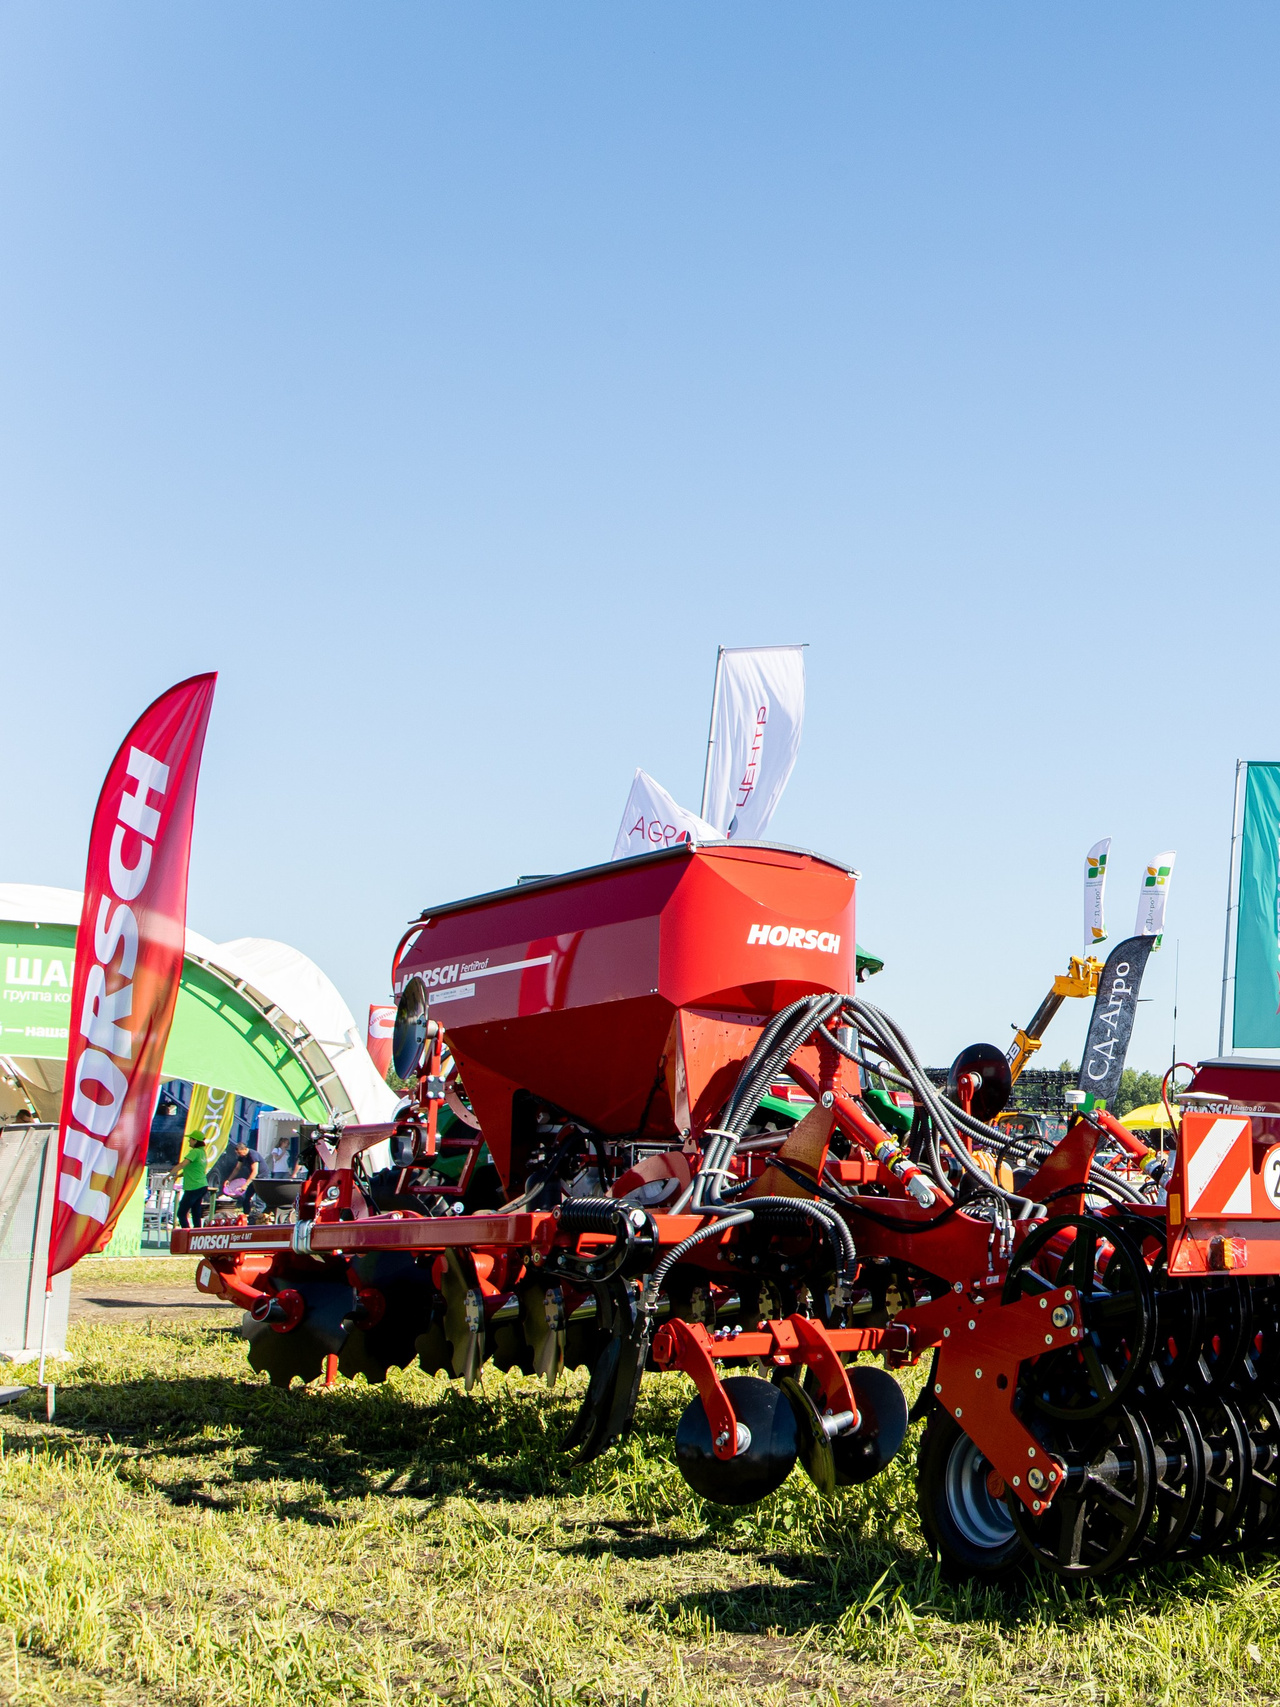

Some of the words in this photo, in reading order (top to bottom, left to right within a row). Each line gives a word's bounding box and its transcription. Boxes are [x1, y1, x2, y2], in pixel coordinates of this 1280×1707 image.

[747, 924, 841, 954] HORSCH
[5, 957, 75, 988] ША
[60, 745, 170, 1224] HORSCH
[3, 990, 53, 1003] группа
[1087, 962, 1132, 1081] СД-Агро
[190, 1235, 230, 1251] HORSCH
